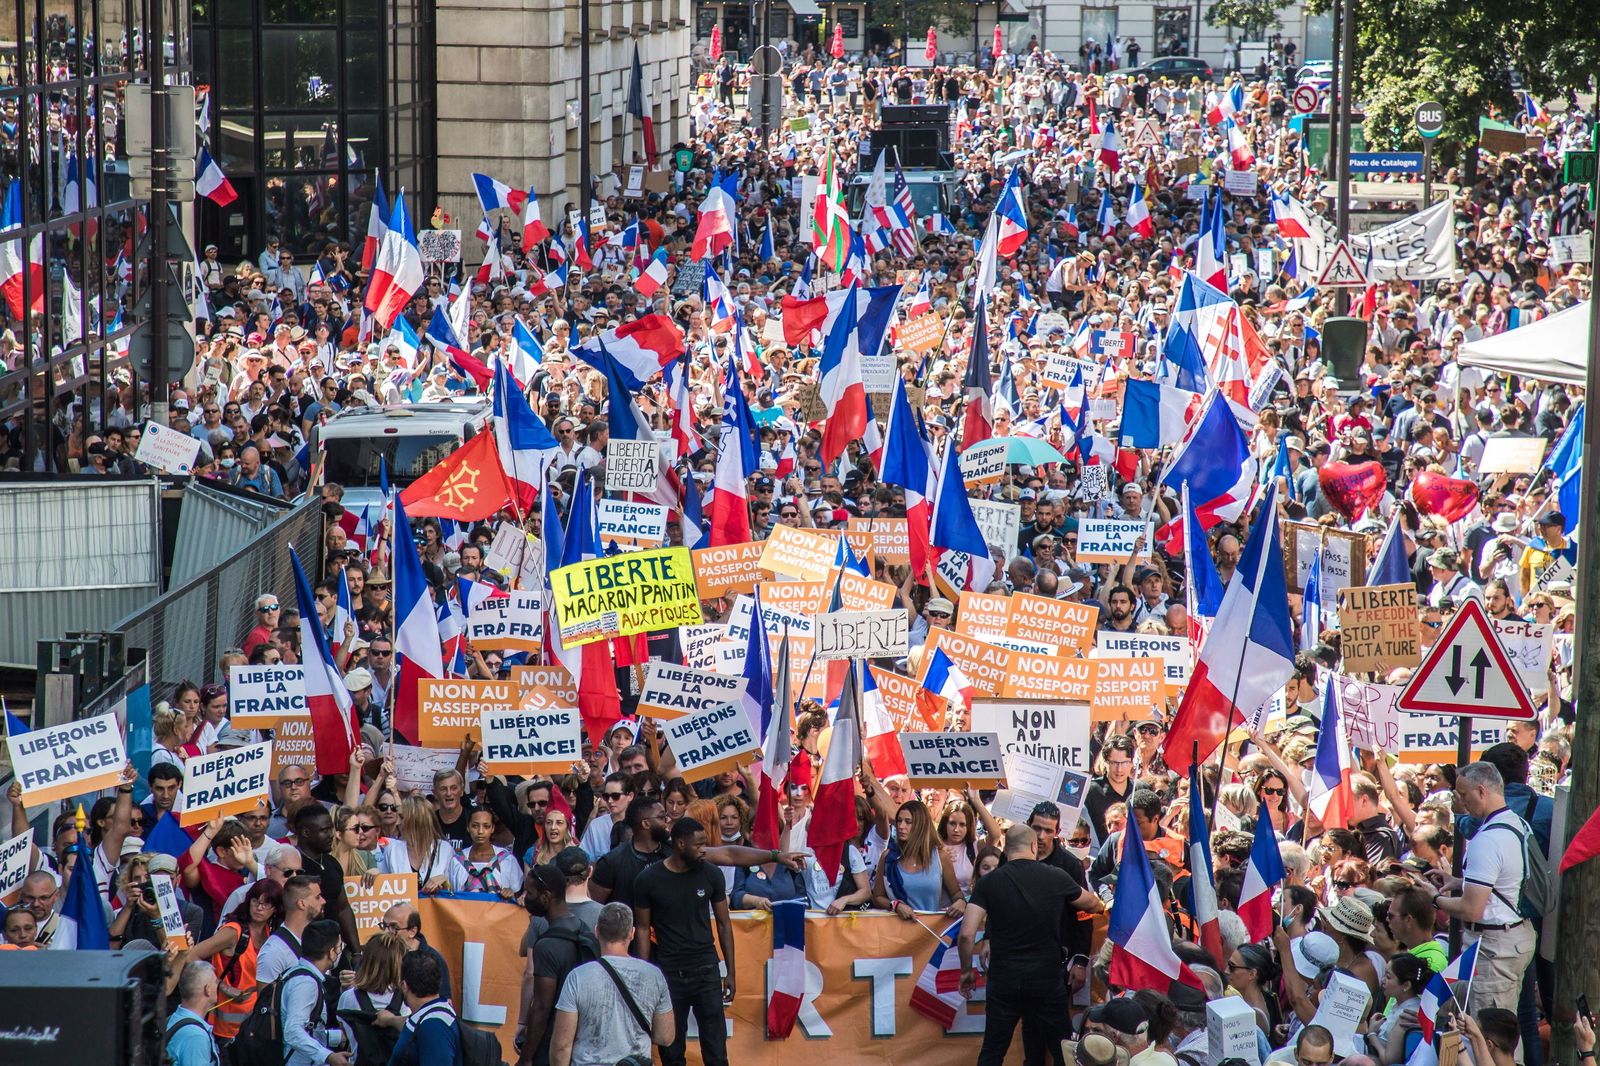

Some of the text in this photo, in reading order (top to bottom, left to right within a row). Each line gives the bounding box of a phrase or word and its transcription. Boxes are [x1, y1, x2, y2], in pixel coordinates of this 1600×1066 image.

[1419, 110, 1442, 122] BUS
[1349, 159, 1418, 169] Place de Catalogne
[901, 322, 923, 336] NON
[609, 442, 658, 459] LIBERTE
[966, 446, 1005, 462] LIBÉRONS
[607, 458, 654, 473] LIBERTA
[962, 461, 1004, 479] FRANCE!
[978, 458, 988, 466] LA
[606, 473, 658, 489] FREEDOM
[605, 504, 661, 516] LIBÉRONS
[600, 522, 661, 536] FRANCE!
[857, 521, 890, 533] NON
[779, 529, 817, 549] NON
[1106, 532, 1121, 540] LA
[770, 540, 832, 566] PASSEPOR
[1080, 542, 1148, 552] FRANC!
[701, 545, 763, 566] NON AU
[950, 555, 963, 570] LA
[1325, 549, 1342, 563] PASS
[698, 560, 760, 578] PASSEPOR
[1328, 566, 1347, 578] PASSE
[1536, 560, 1562, 592] MORT
[707, 572, 763, 587] SANITAIRE
[769, 586, 805, 599] NON
[868, 585, 889, 601] AU
[1351, 588, 1417, 611] LIBERTE
[563, 586, 637, 623] MACARON
[968, 597, 1007, 613] NON
[1020, 598, 1090, 623] NON AU
[622, 611, 650, 630] AUX
[961, 612, 1008, 627] PASSEP
[1356, 607, 1418, 623] FREEDOM
[1012, 613, 1090, 639] PASSEPORT
[1343, 622, 1417, 642] STOP THE
[1016, 628, 1078, 648] SANITAIRE
[1106, 637, 1181, 652] LIBÉRONS
[689, 648, 703, 659] LA
[937, 634, 1010, 667] NON AU
[1343, 639, 1417, 660] DICTATURE
[238, 668, 304, 685] LIBÉRON
[1017, 656, 1090, 681] NON AU
[1098, 662, 1124, 678] ON
[1129, 662, 1155, 677] AU
[521, 671, 563, 686] NON
[657, 668, 738, 690] LIBÉRONS
[875, 673, 913, 700] NON
[1009, 675, 1091, 696] PASSEPORT
[1096, 680, 1160, 693] SSEPORT
[266, 683, 287, 694] LA
[430, 684, 477, 700] NON
[481, 685, 509, 700] AU
[681, 682, 702, 694] LA
[234, 694, 309, 714] FRANC
[1094, 695, 1151, 706] ANITAIRE
[432, 716, 482, 728] SANITA
[490, 713, 571, 730] LIBÉRONS
[671, 704, 737, 739] LIBÉRONS
[1012, 709, 1056, 730] NON
[282, 722, 307, 737] NON
[518, 728, 540, 740] LA
[697, 728, 717, 742] LA
[1016, 728, 1041, 742] AU
[19, 720, 108, 756] LIBÉRONS
[275, 740, 315, 752] PASSEPO
[910, 733, 990, 750] LIBÉRONS
[52, 743, 78, 760] LA
[487, 740, 576, 760] FRANCE!
[678, 729, 752, 768] FRANCE!
[940, 747, 961, 758] LA
[21, 747, 120, 790] FRANCE!
[192, 746, 265, 778] LIBÉRONS
[911, 759, 999, 776] FRANCE!
[216, 768, 235, 782] LA
[186, 773, 265, 810] FRANCE!
[344, 879, 407, 898] ON AU
[1224, 1020, 1241, 1029] NOUS
[1233, 1042, 1256, 1052] MACRON
